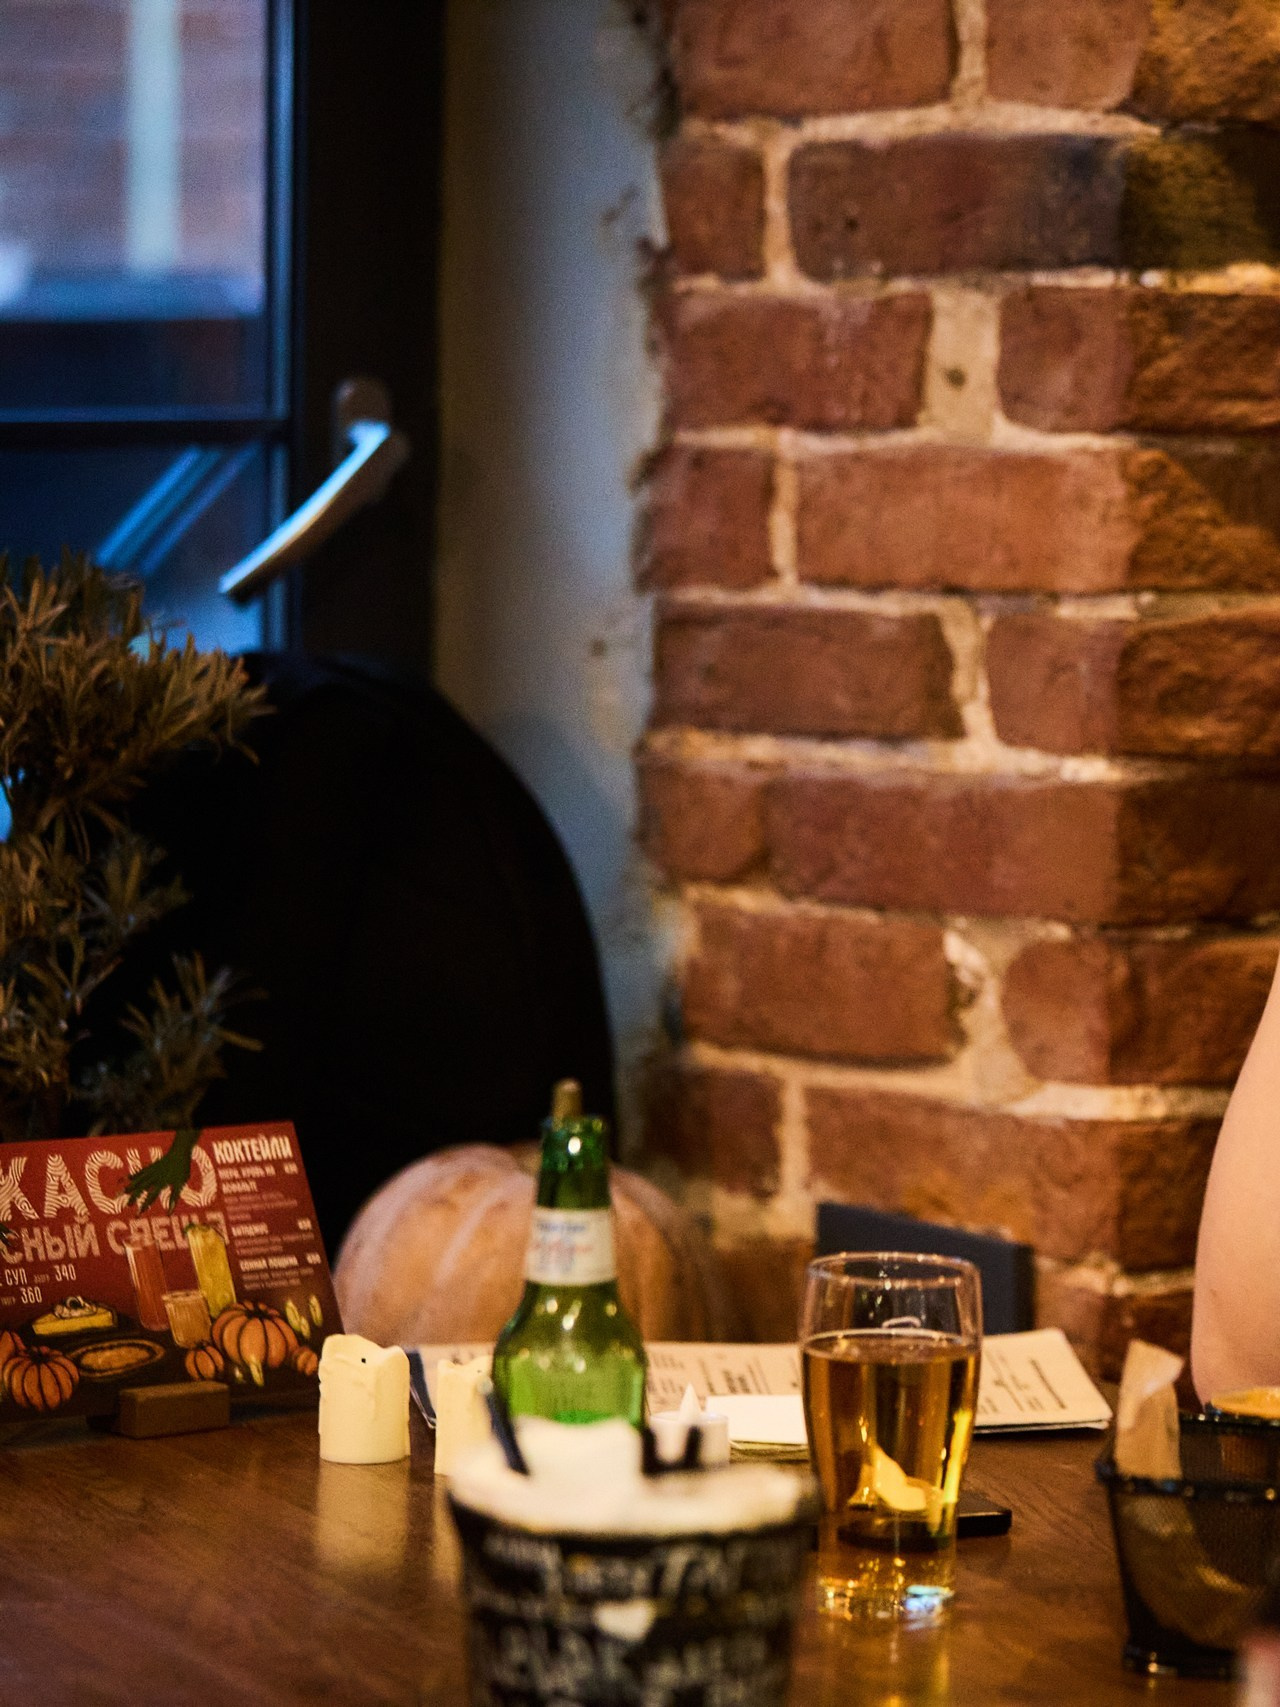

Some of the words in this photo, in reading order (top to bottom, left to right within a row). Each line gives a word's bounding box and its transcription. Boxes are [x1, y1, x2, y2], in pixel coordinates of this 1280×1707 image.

[212, 1134, 293, 1164] КОКТЕЙЛИ
[5, 1267, 28, 1286] СУП
[54, 1263, 77, 1282] 340
[20, 1286, 43, 1304] 360
